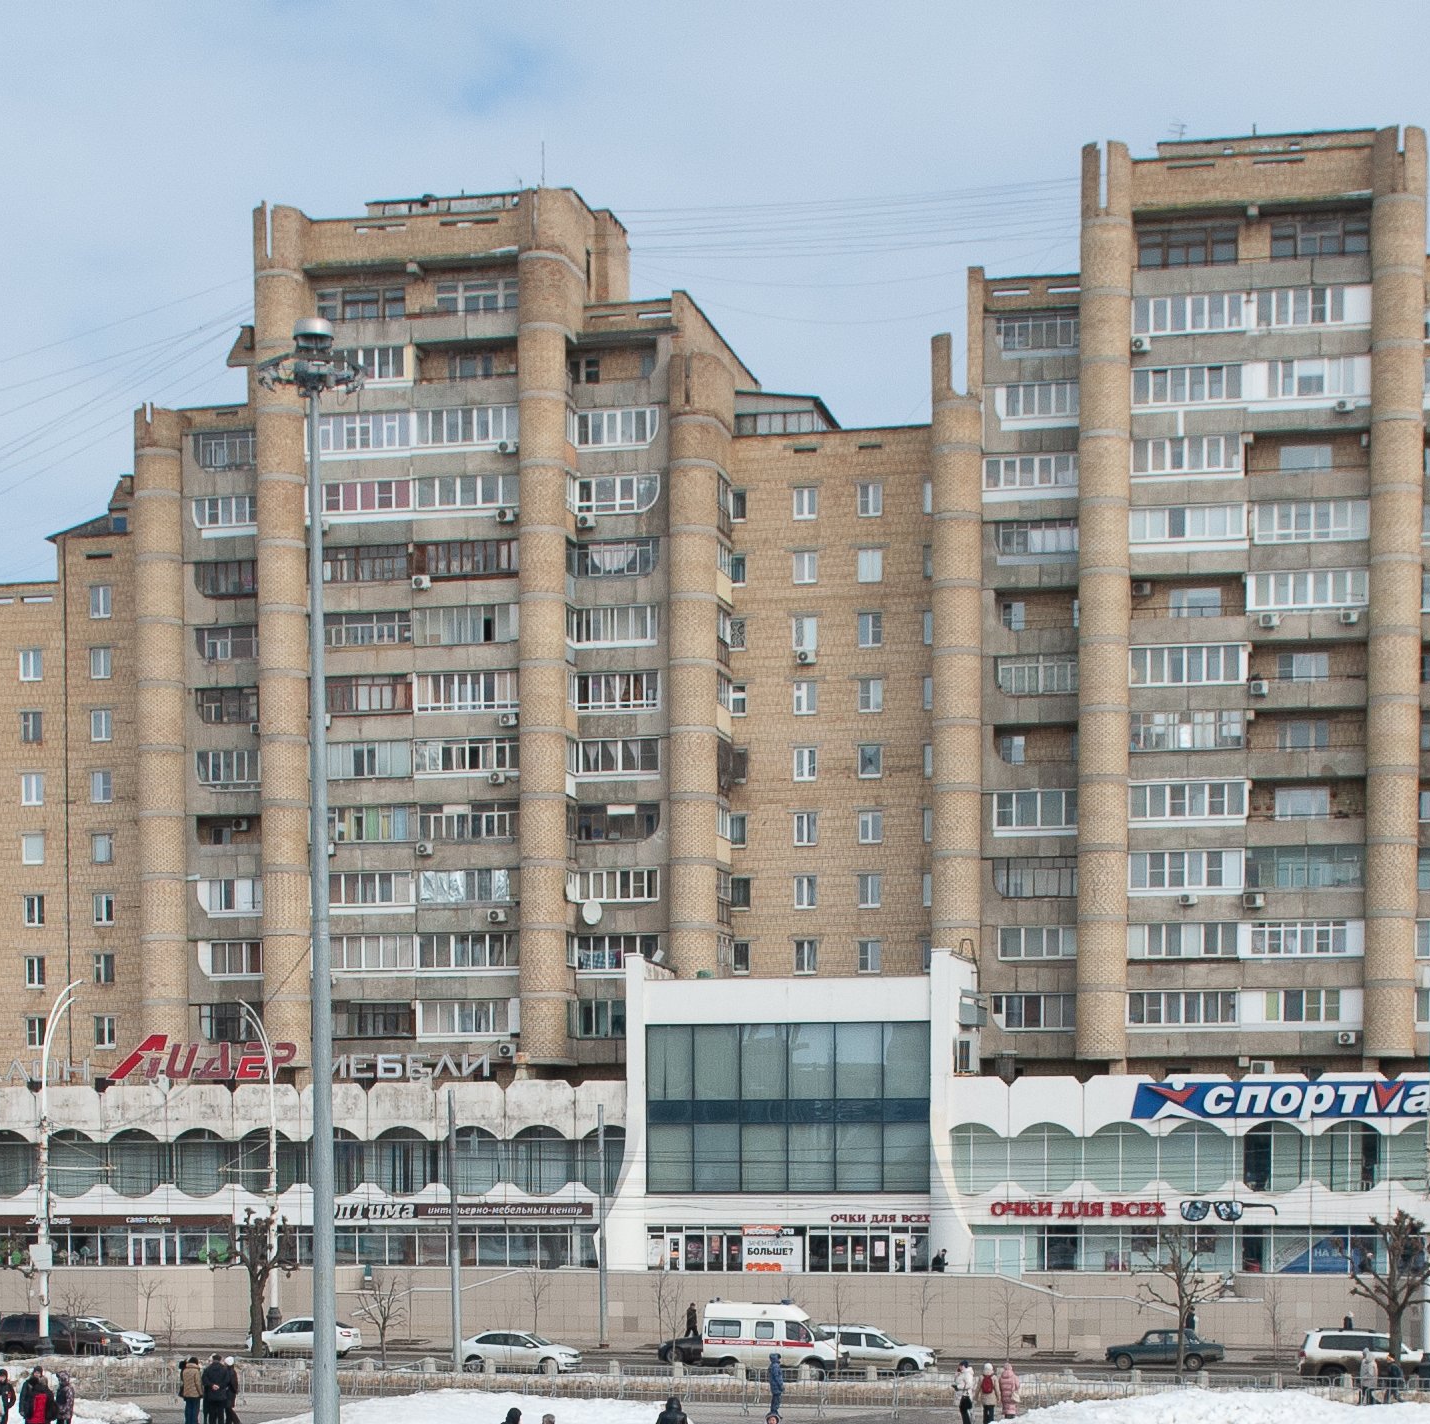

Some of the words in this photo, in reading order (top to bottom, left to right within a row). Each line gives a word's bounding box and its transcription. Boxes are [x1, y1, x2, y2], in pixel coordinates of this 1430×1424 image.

[549, 1206, 583, 1217] центр
[991, 1202, 1053, 1217] ОЧКИ
[1058, 1202, 1105, 1219] ДЛЯ
[1110, 1202, 1167, 1217] ВСЕХ
[830, 1214, 866, 1224] ОЧКИ
[870, 1214, 897, 1225] ДЛЯ
[901, 1214, 931, 1224] ВСЕХ
[747, 1247, 794, 1256] БОЛЬШЕ?
